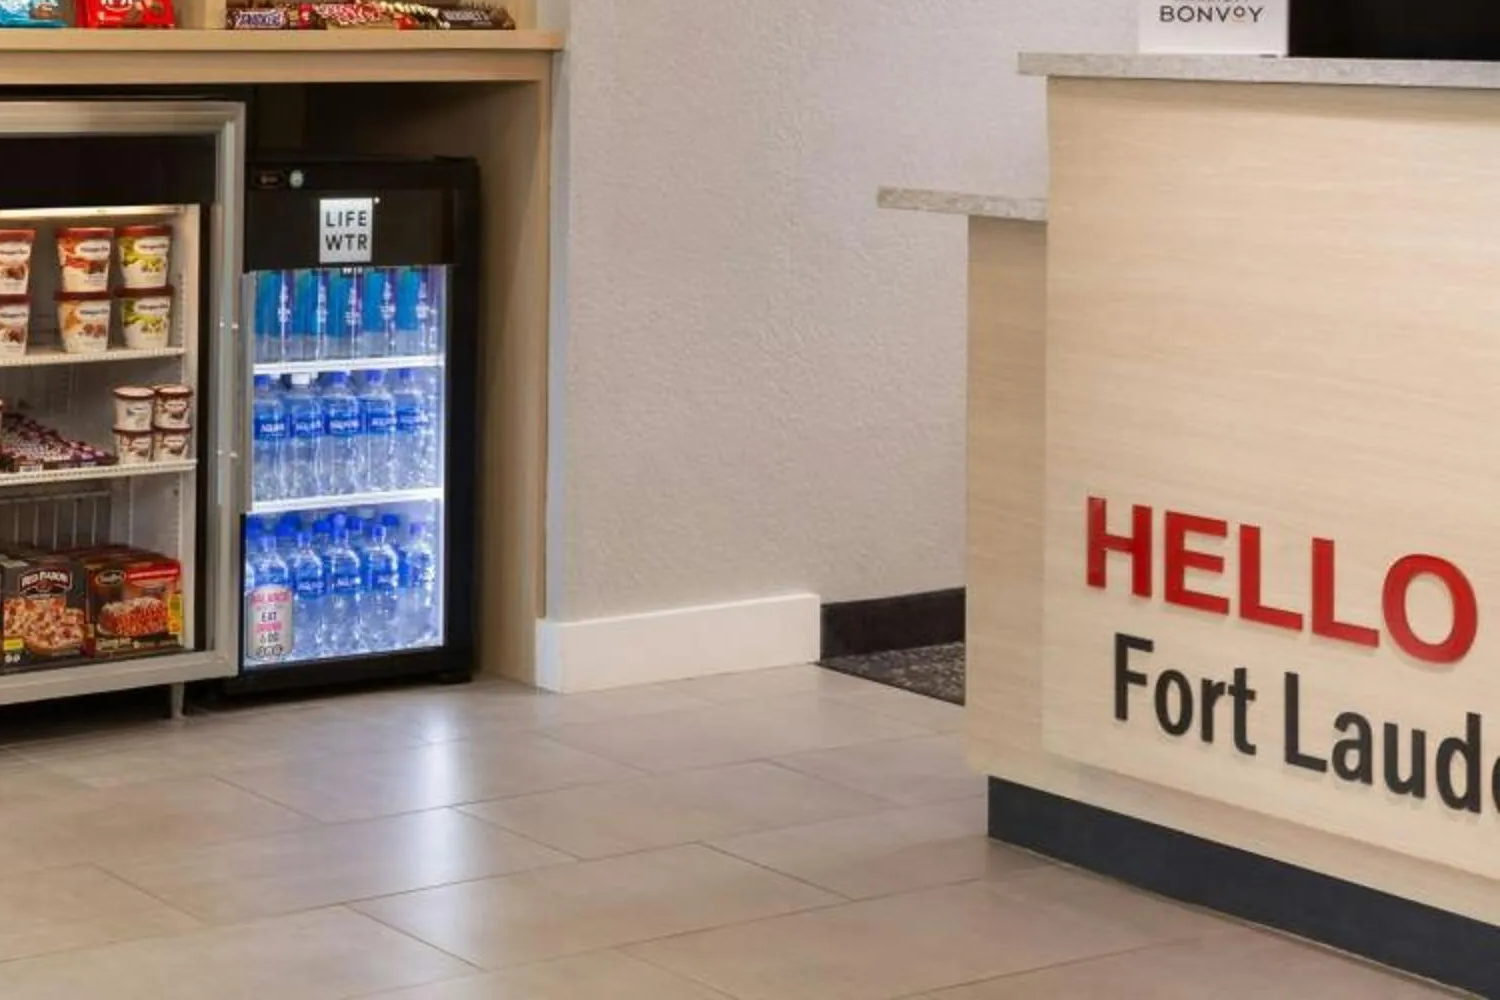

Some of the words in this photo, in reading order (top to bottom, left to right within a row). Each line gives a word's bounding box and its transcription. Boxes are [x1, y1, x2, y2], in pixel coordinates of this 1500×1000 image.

[1159, 5, 1264, 23] BONVOY
[325, 211, 367, 227] LIFE
[325, 233, 368, 250] WTR
[1086, 496, 1478, 664] HELLO
[1114, 632, 1257, 756] Fort
[1284, 670, 1500, 824] Laud
